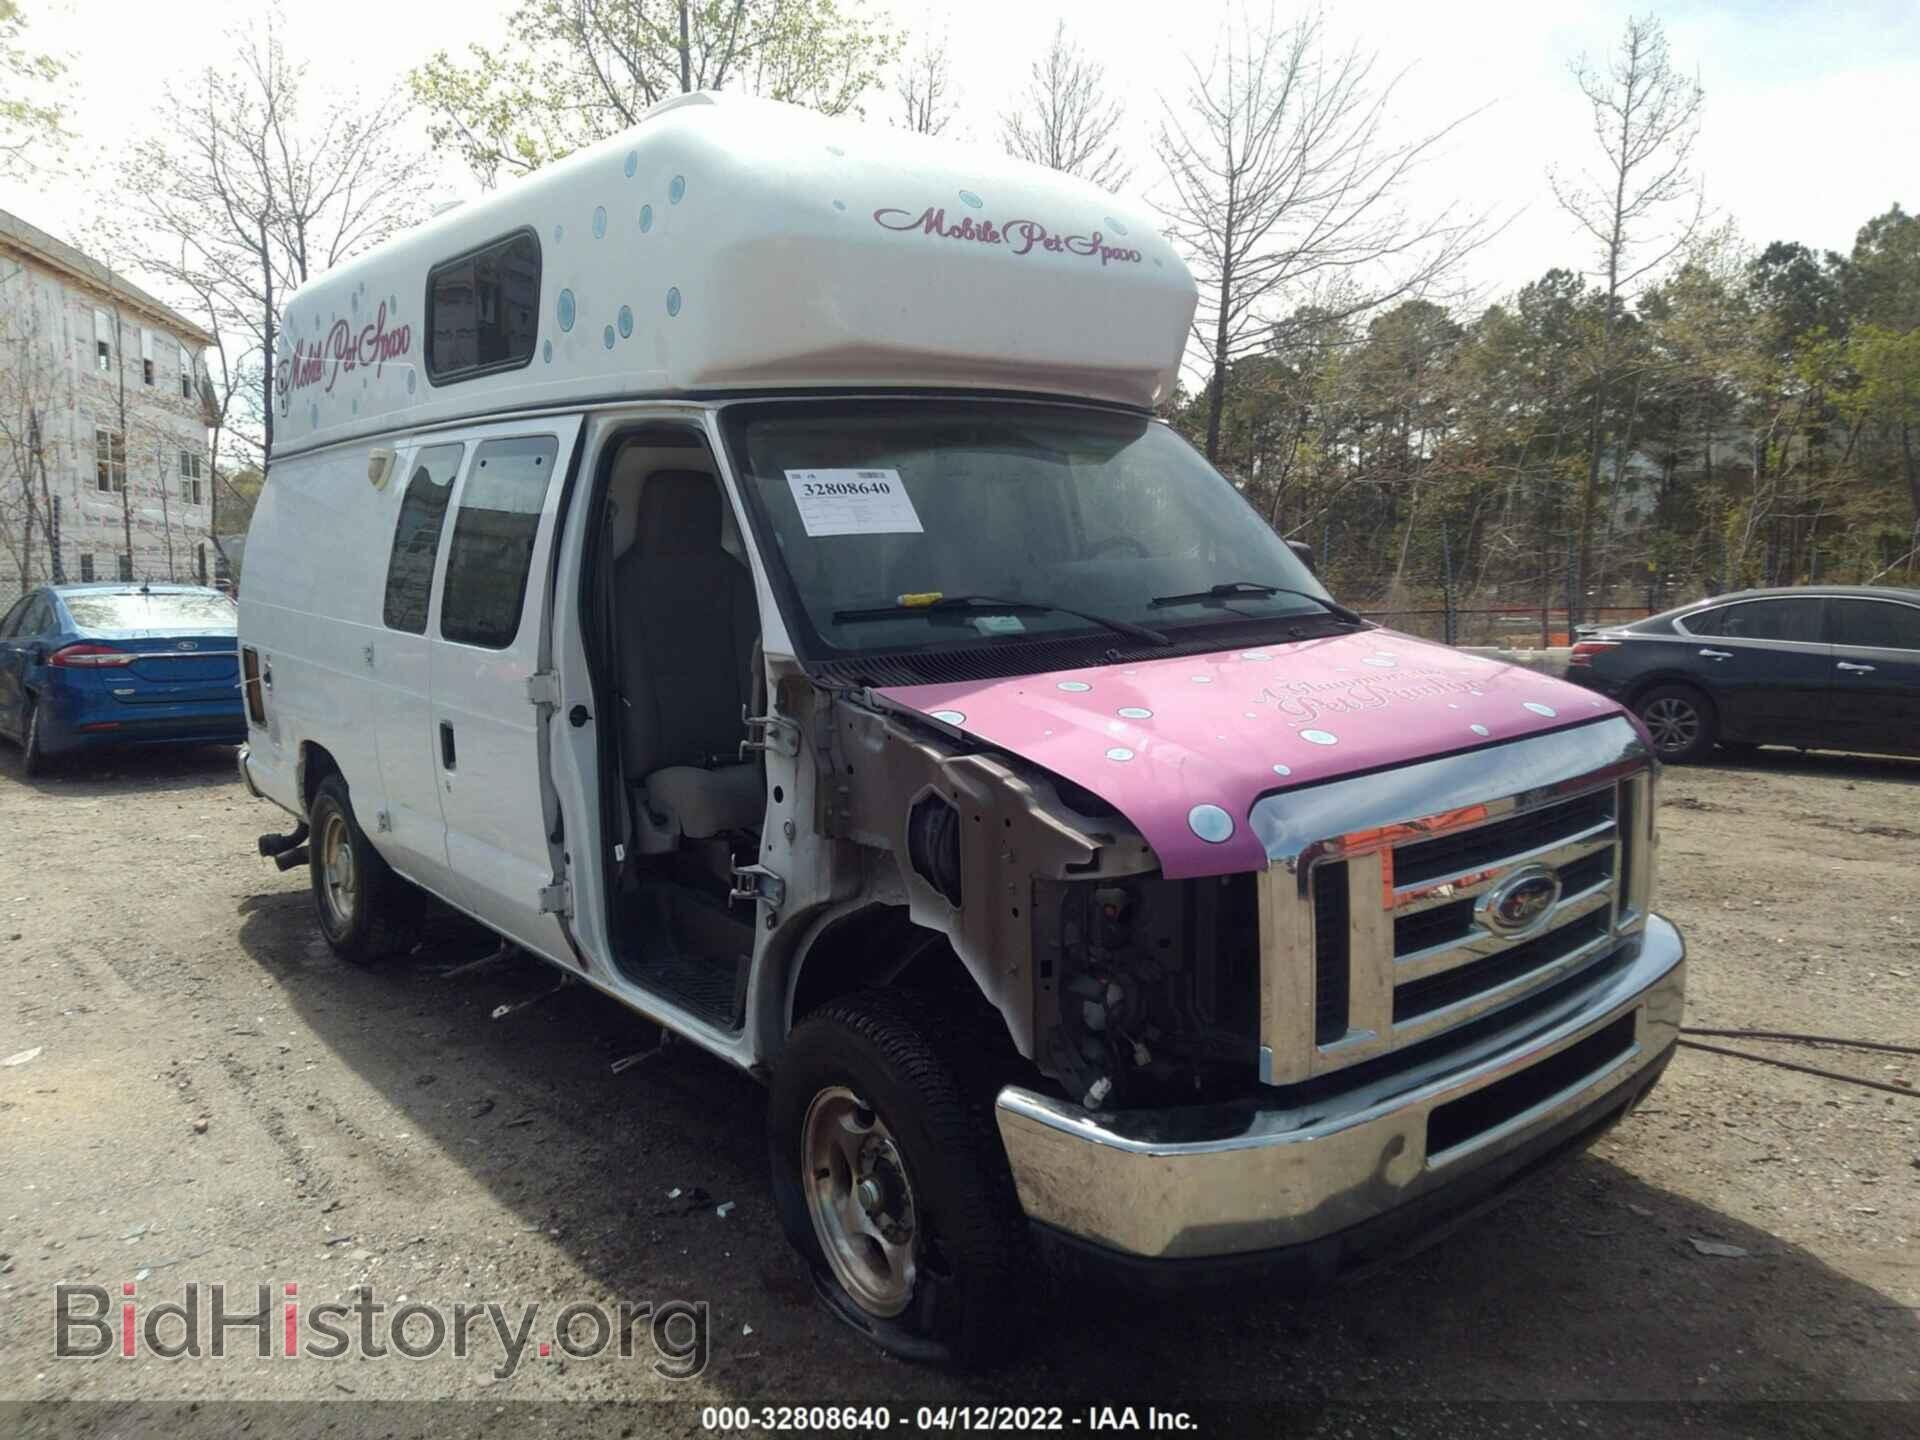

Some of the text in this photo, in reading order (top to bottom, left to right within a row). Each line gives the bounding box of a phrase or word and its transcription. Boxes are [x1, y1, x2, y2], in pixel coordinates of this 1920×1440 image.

[873, 207, 1001, 244] Mobile
[1002, 219, 1064, 255] Pet
[803, 482, 891, 497] 32808640
